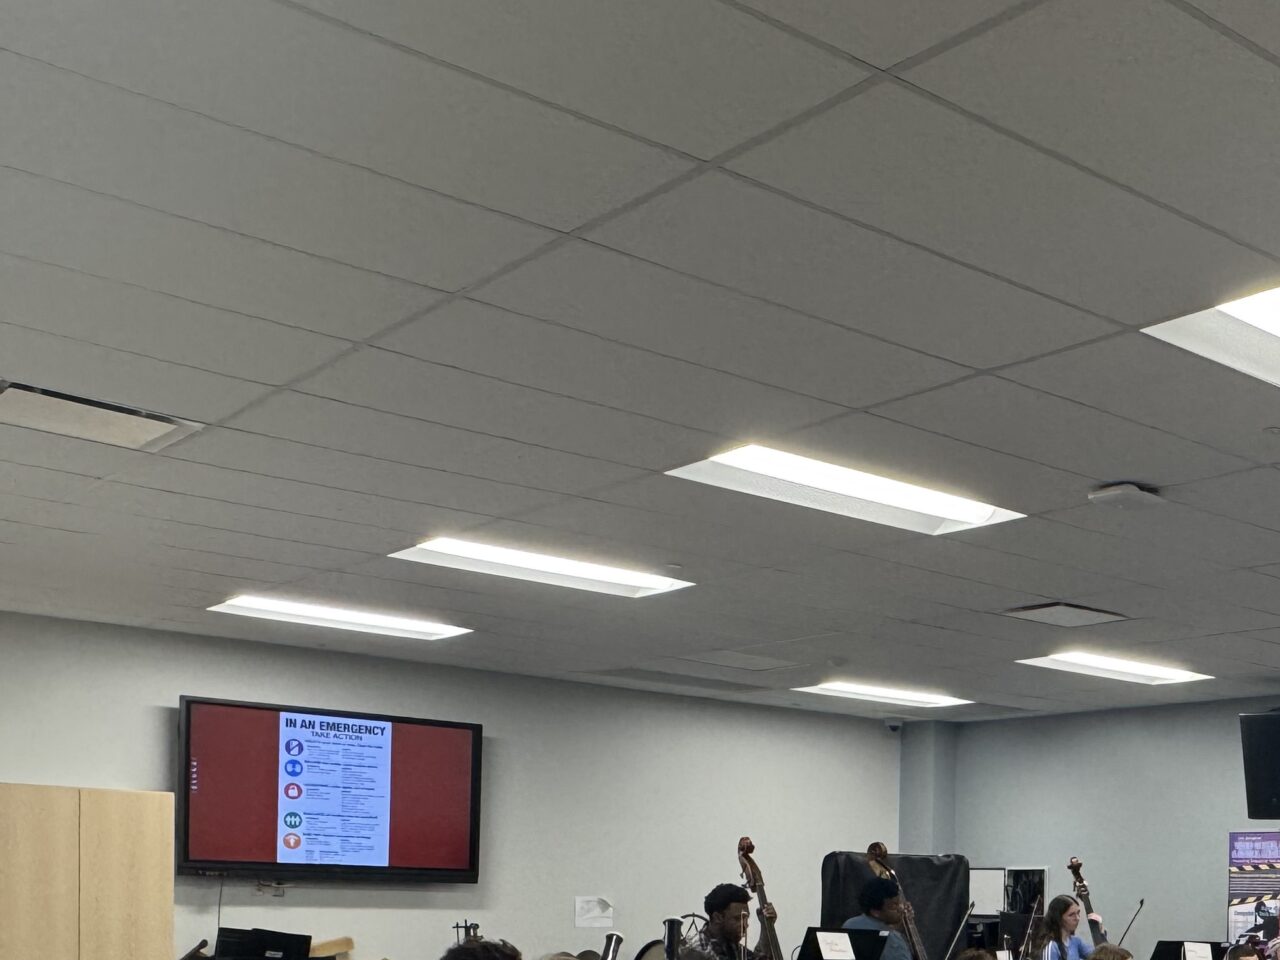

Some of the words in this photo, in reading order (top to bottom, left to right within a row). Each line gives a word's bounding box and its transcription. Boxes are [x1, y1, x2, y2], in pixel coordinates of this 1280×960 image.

[285, 718, 297, 728] IN
[300, 719, 316, 730] AN
[320, 721, 386, 736] EMERGENCY
[310, 731, 331, 739] TAKE
[333, 733, 363, 741] ACTION
